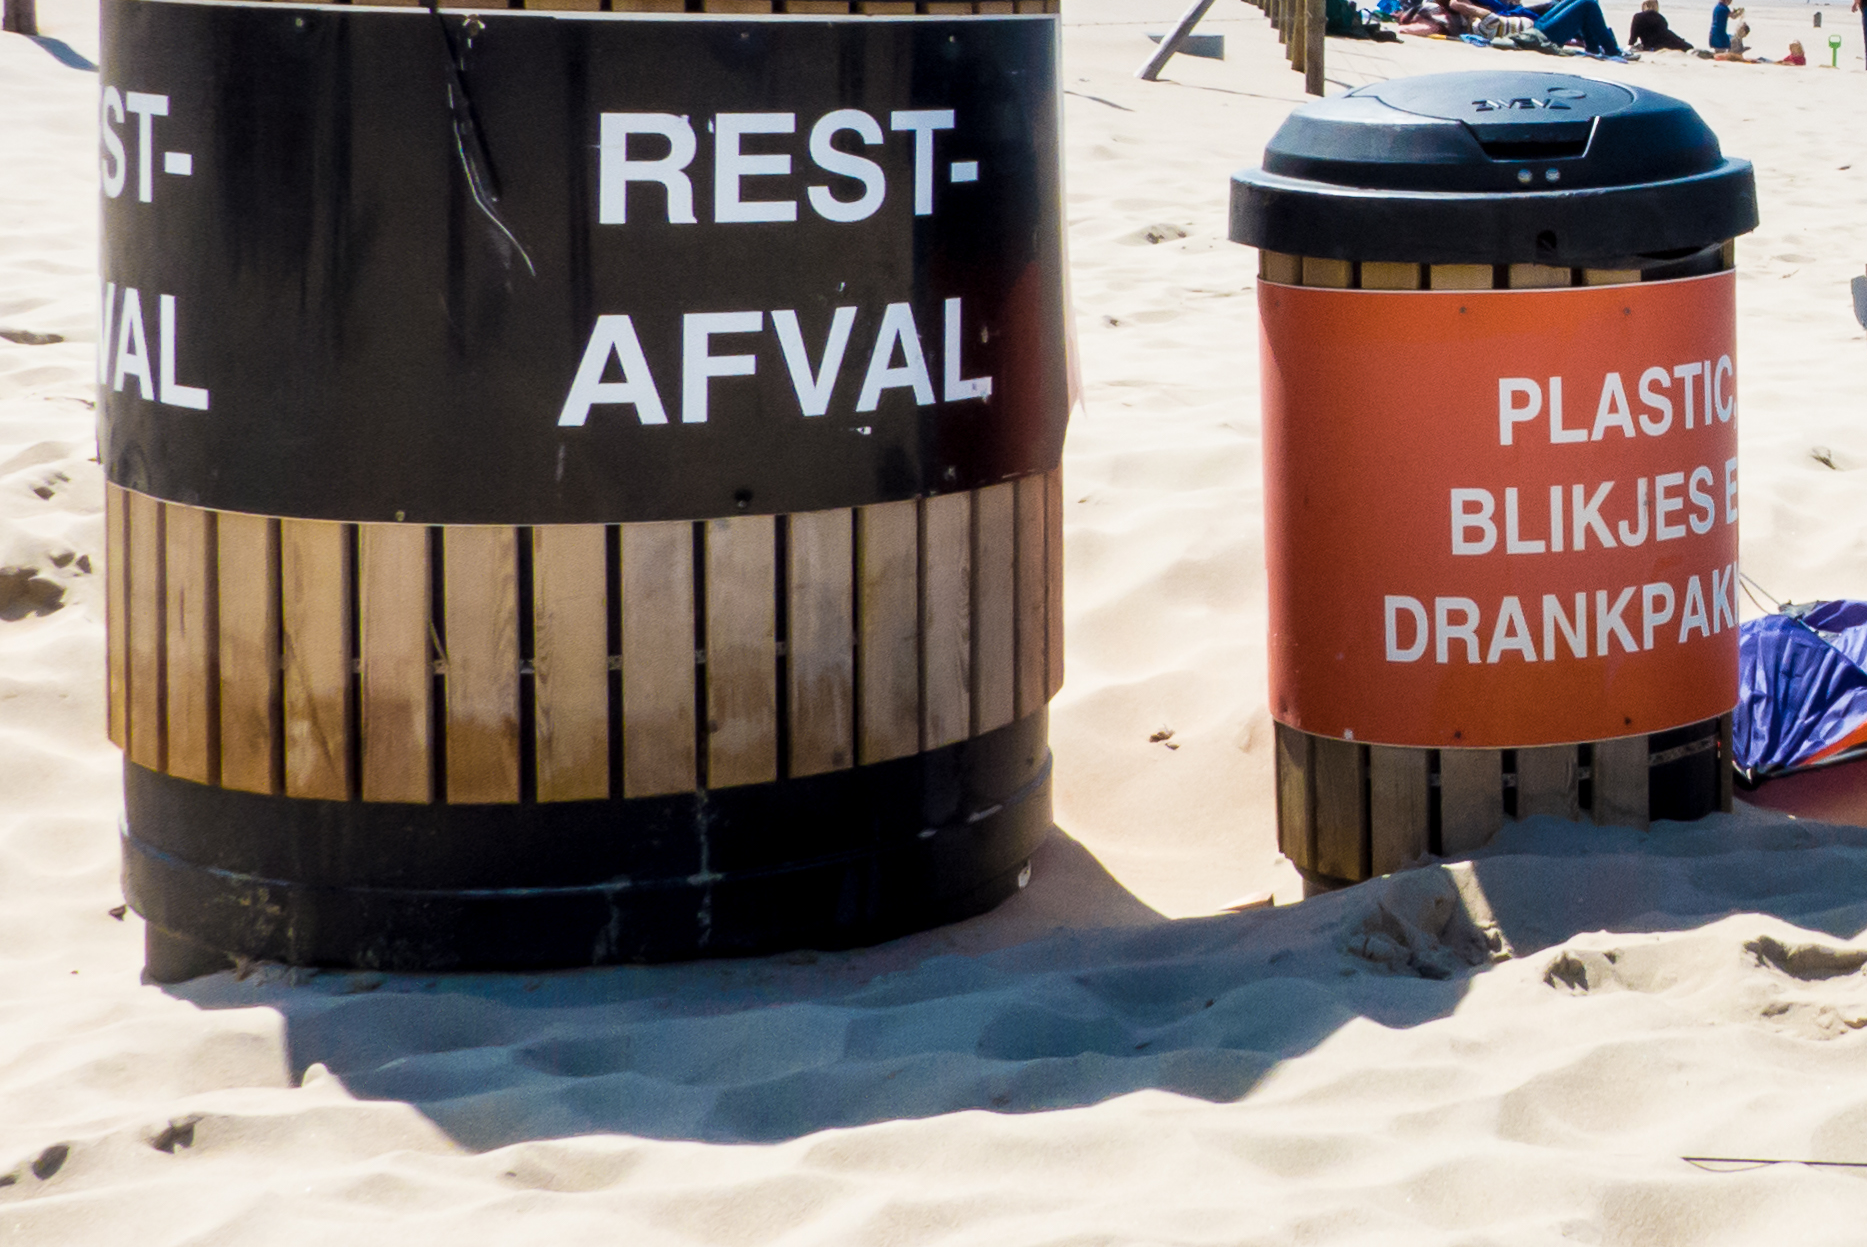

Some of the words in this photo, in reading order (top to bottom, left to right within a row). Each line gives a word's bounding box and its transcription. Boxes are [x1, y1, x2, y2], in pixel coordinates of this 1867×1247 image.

[598, 108, 980, 224] REST-
[557, 297, 992, 427] AFVAL
[1450, 465, 1716, 555] BLIKJES
[1383, 560, 1739, 664] DRANKPAK
